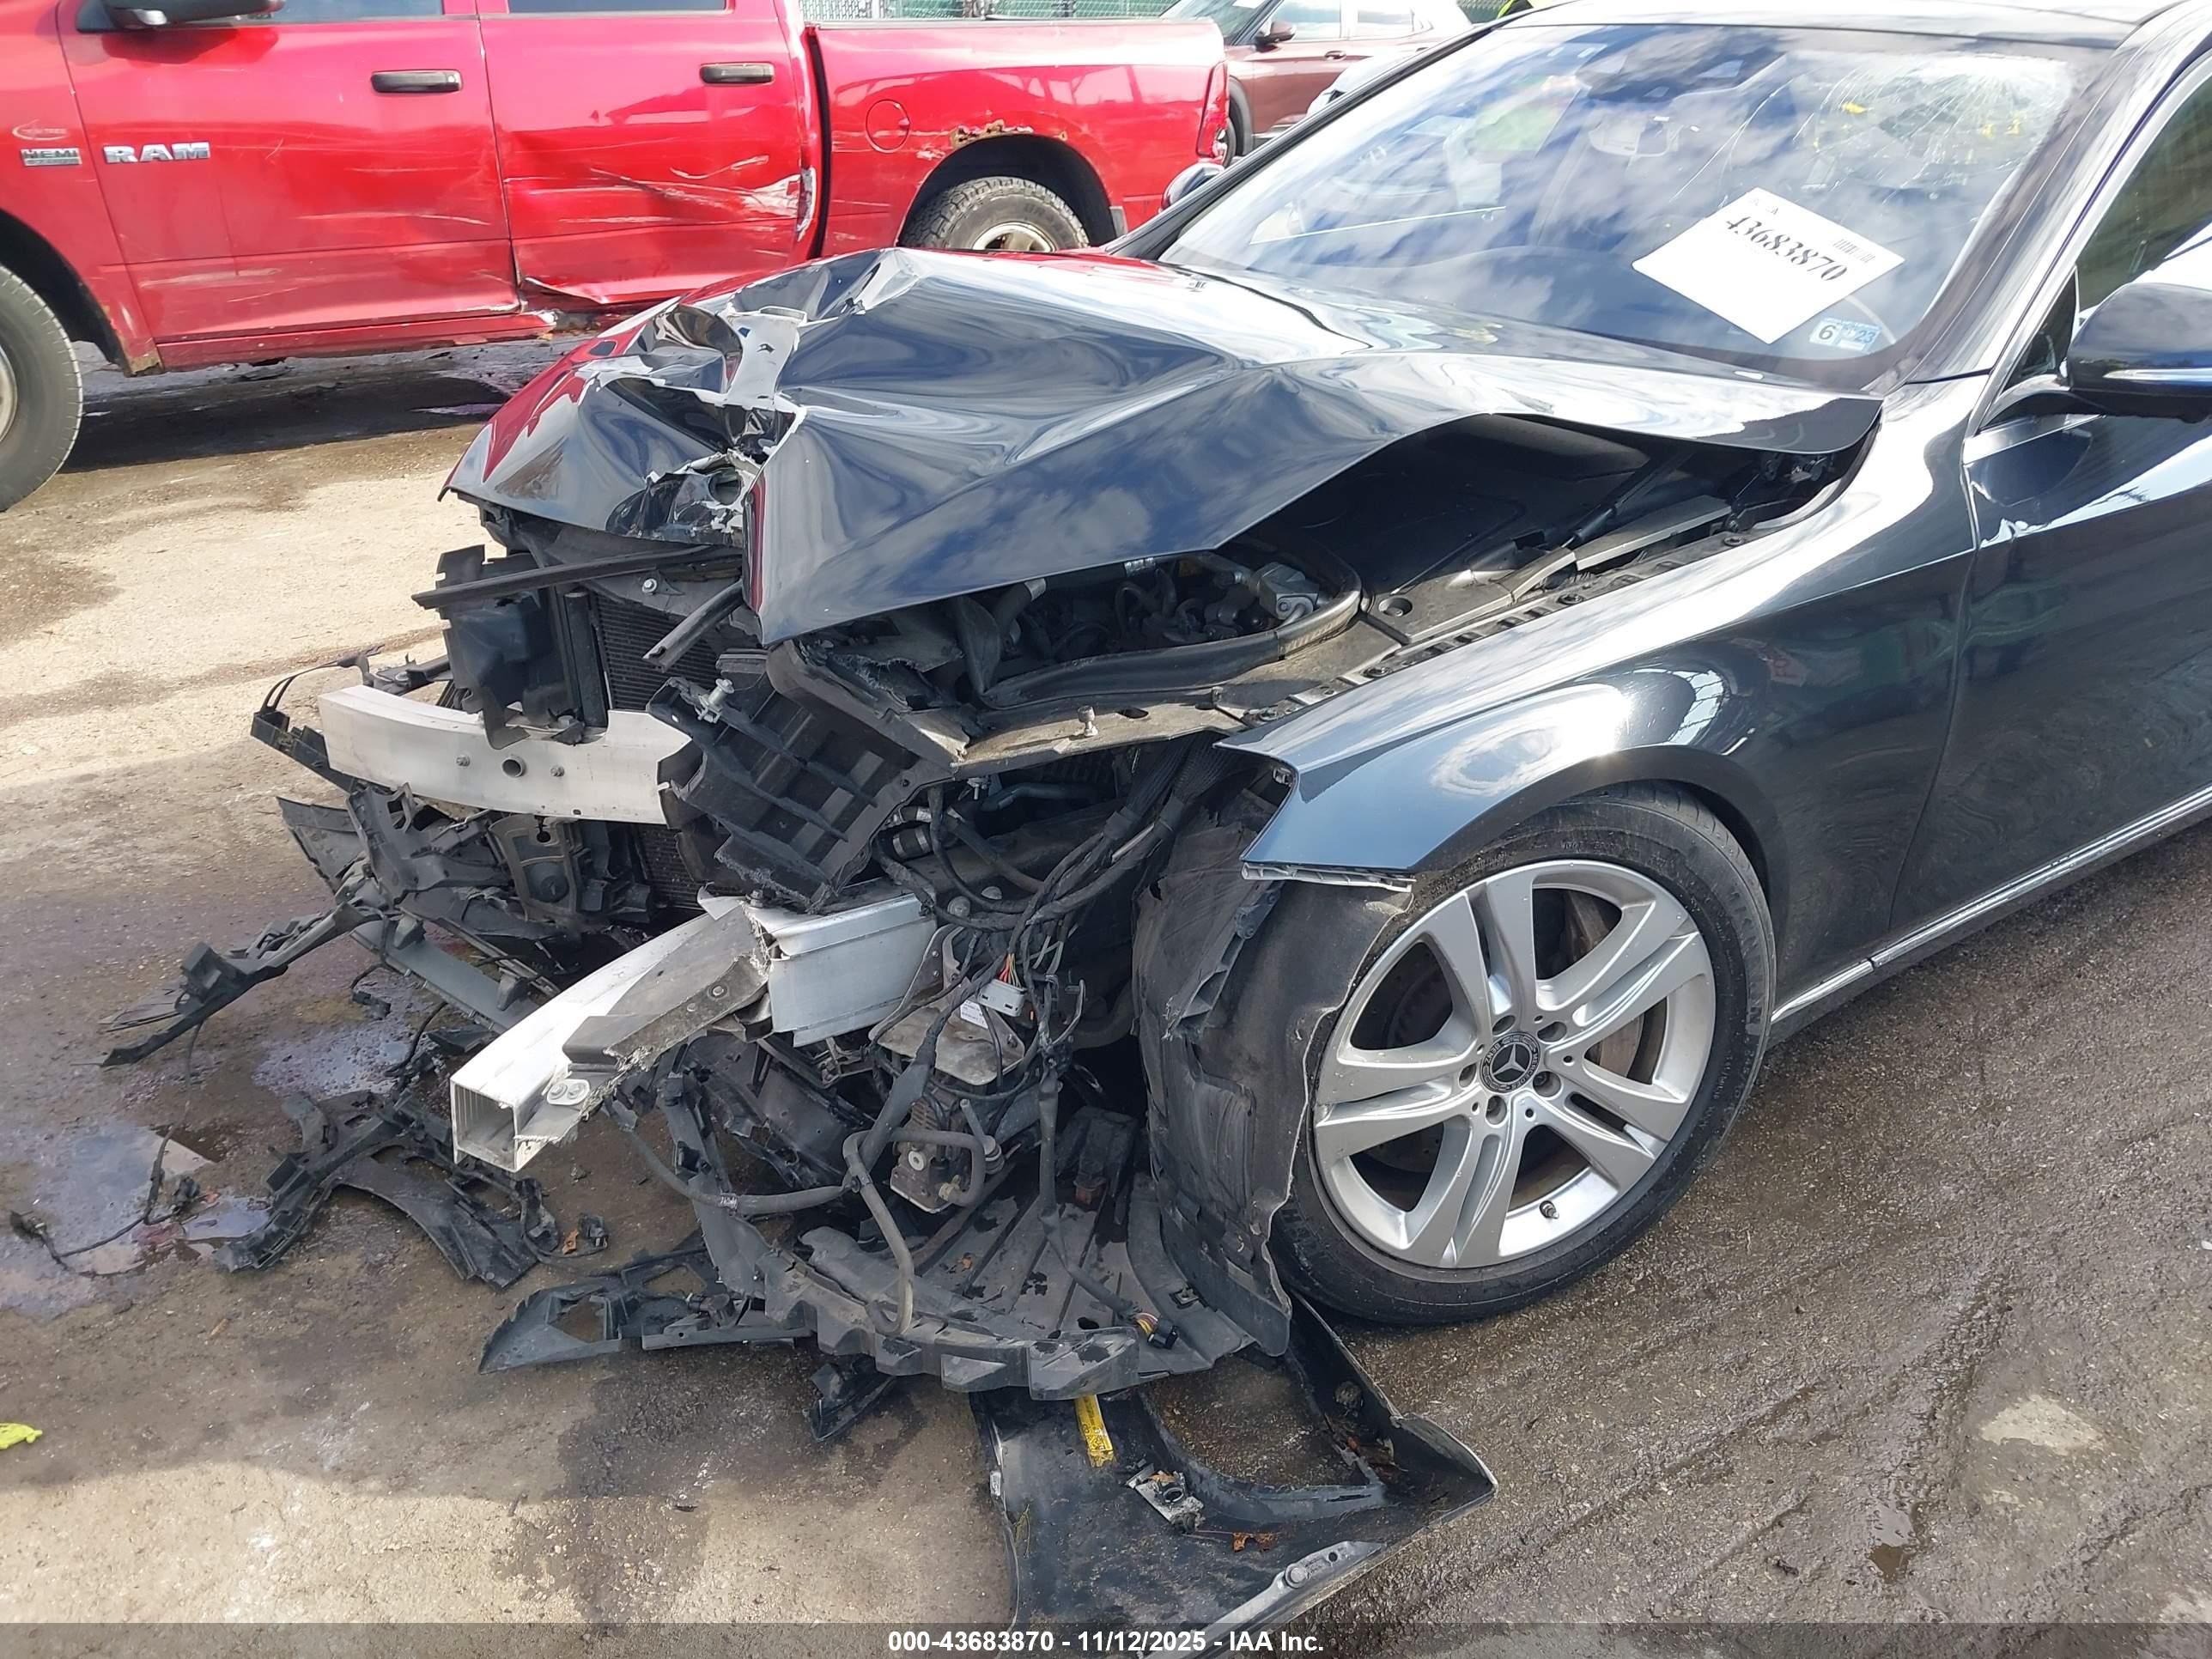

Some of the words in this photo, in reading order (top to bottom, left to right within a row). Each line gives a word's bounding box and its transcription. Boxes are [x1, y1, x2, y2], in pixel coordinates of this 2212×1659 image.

[22, 149, 78, 159] HEMI
[103, 142, 210, 163] RAM
[1726, 216, 1848, 281] 43683870
[1819, 325, 1837, 340] 6
[1855, 330, 1876, 343] 23
[1484, 1042, 1501, 1064] BENZ
